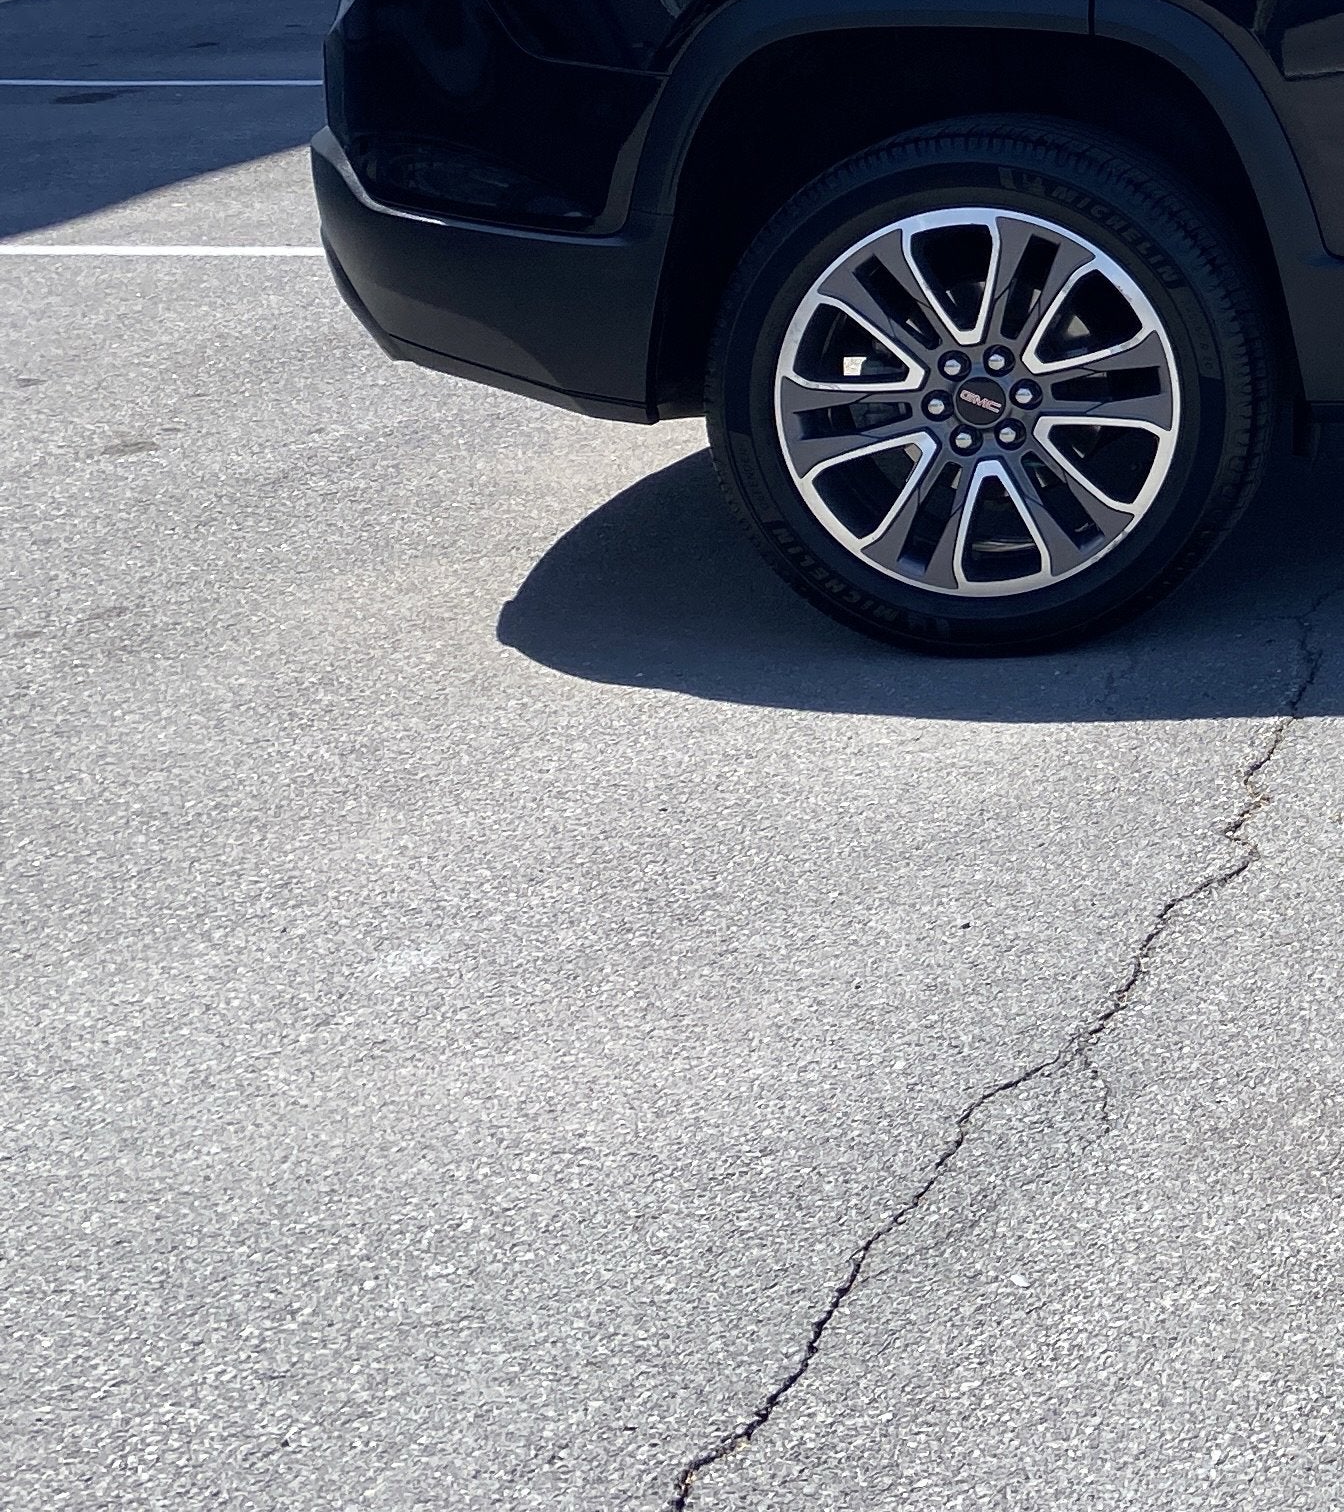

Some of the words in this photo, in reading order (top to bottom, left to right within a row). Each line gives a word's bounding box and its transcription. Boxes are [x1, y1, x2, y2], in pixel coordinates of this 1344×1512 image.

[1051, 186, 1181, 289] MICHELIN
[960, 389, 1002, 414] GMC
[769, 525, 900, 622] MICHELIN
